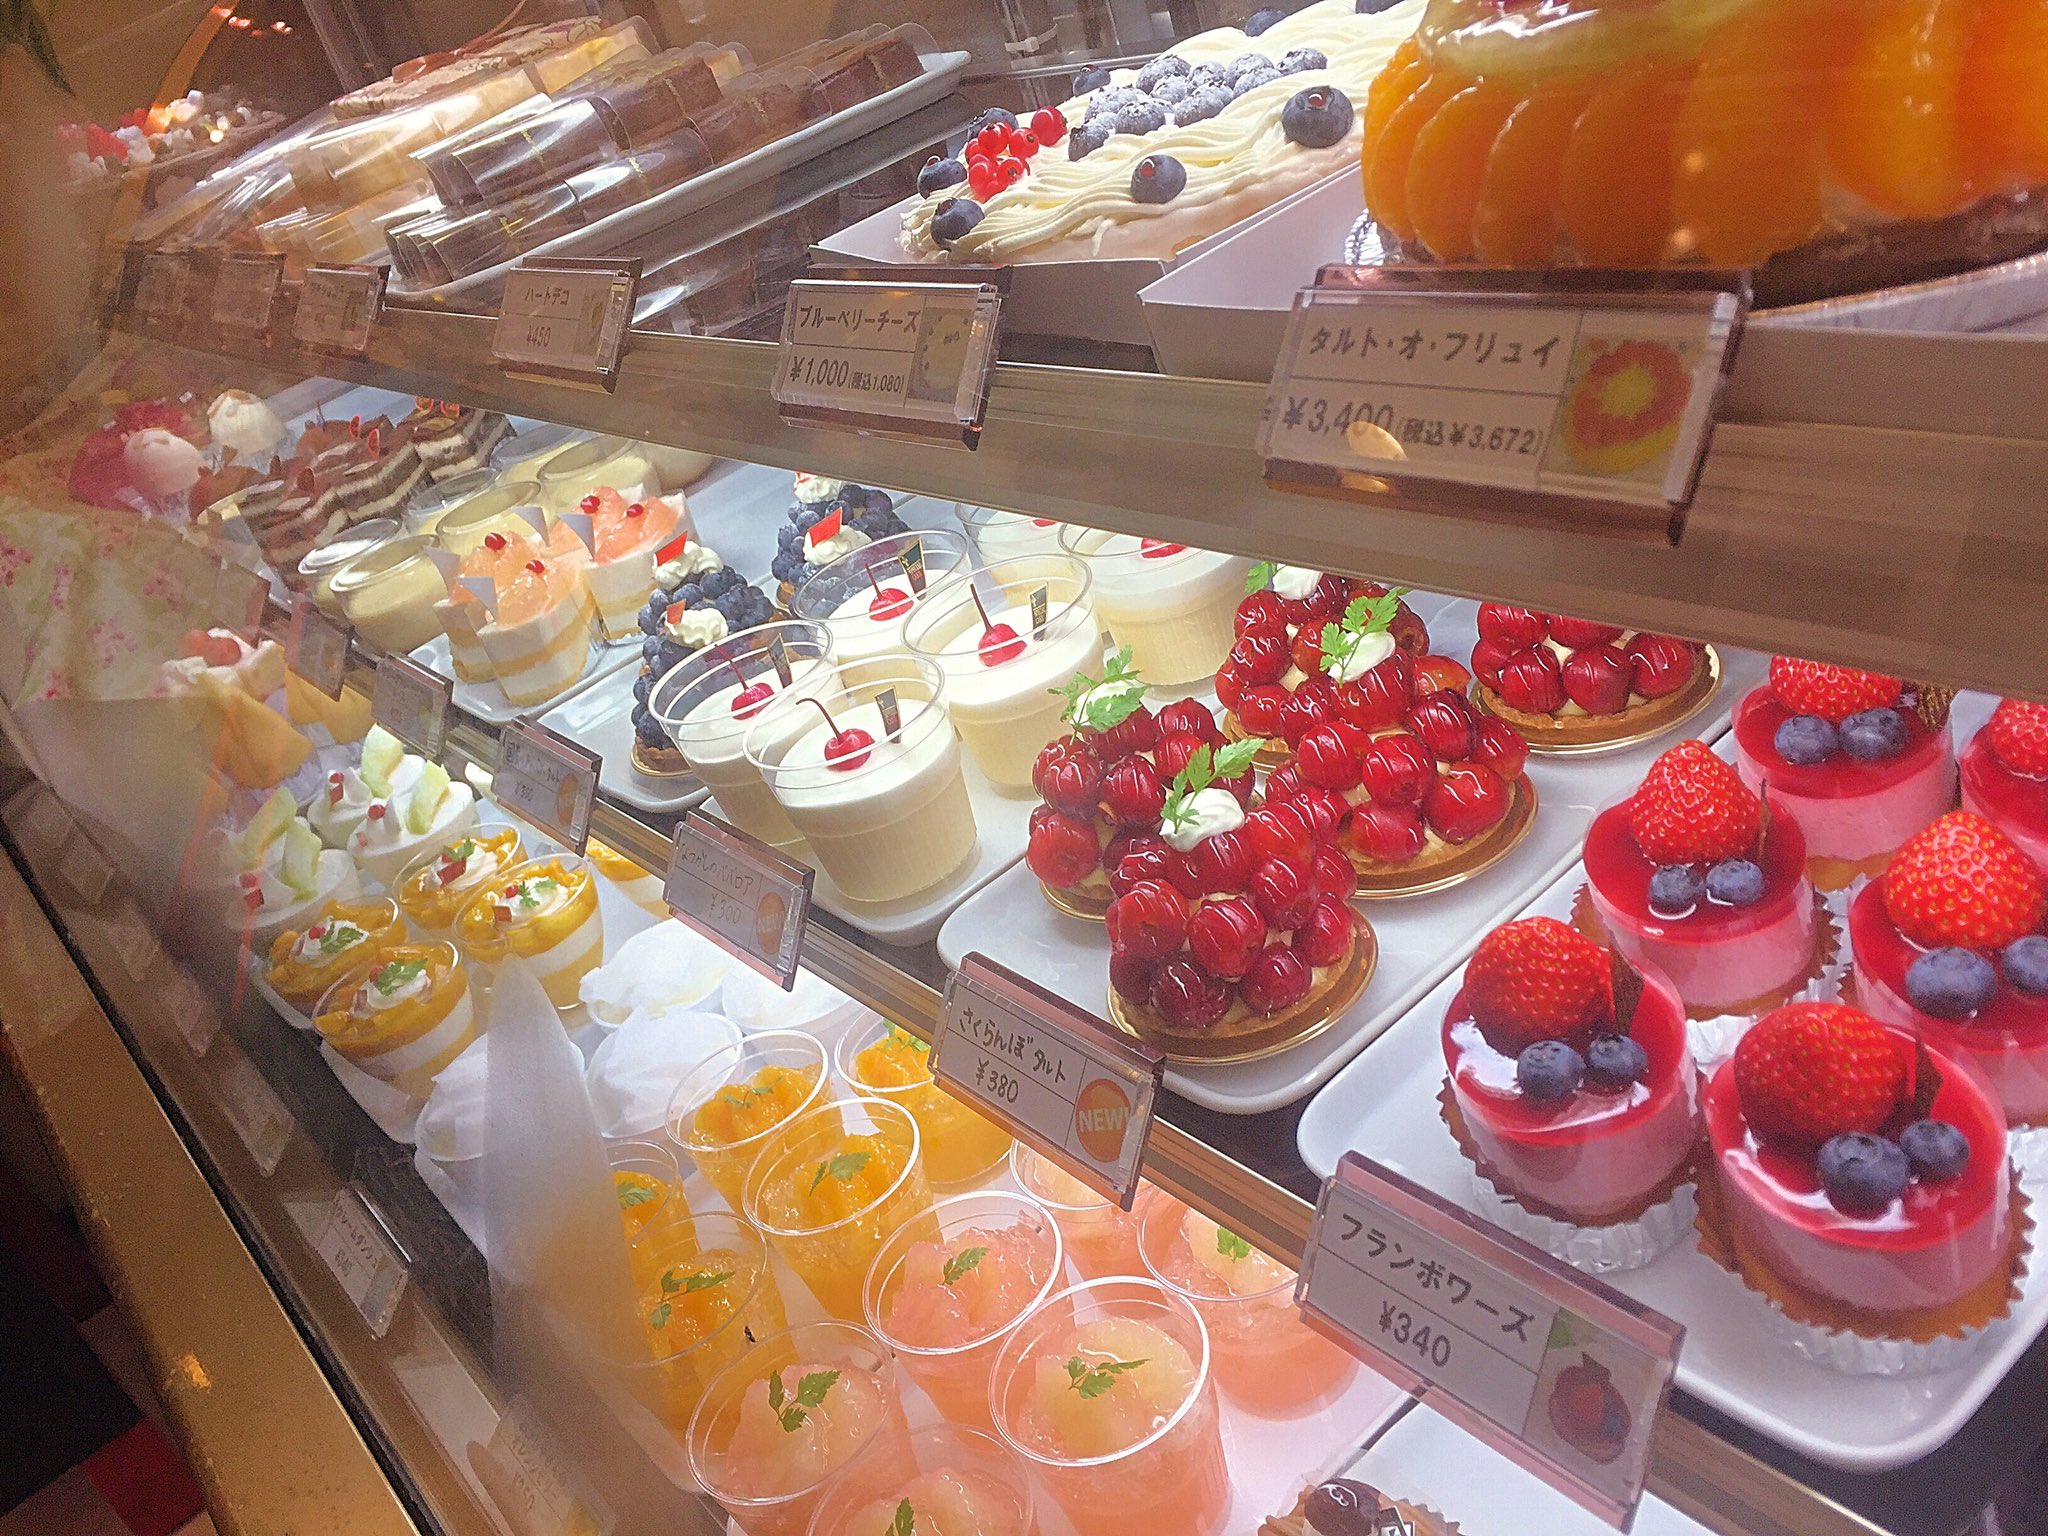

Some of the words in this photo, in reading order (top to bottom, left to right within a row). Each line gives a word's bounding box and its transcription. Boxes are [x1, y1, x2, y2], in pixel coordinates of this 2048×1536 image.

[524, 286, 570, 306] ハートデコ
[526, 325, 552, 347] ¥450
[800, 305, 921, 333] ブルーベリーチーズ
[1309, 326, 1562, 368] タルト・オ・フリュイ
[790, 356, 849, 387] ¥1,000
[976, 1058, 1019, 1104] ¥380
[1340, 1213, 1535, 1343] フランボワーズ
[1378, 1300, 1453, 1368] ¥340
